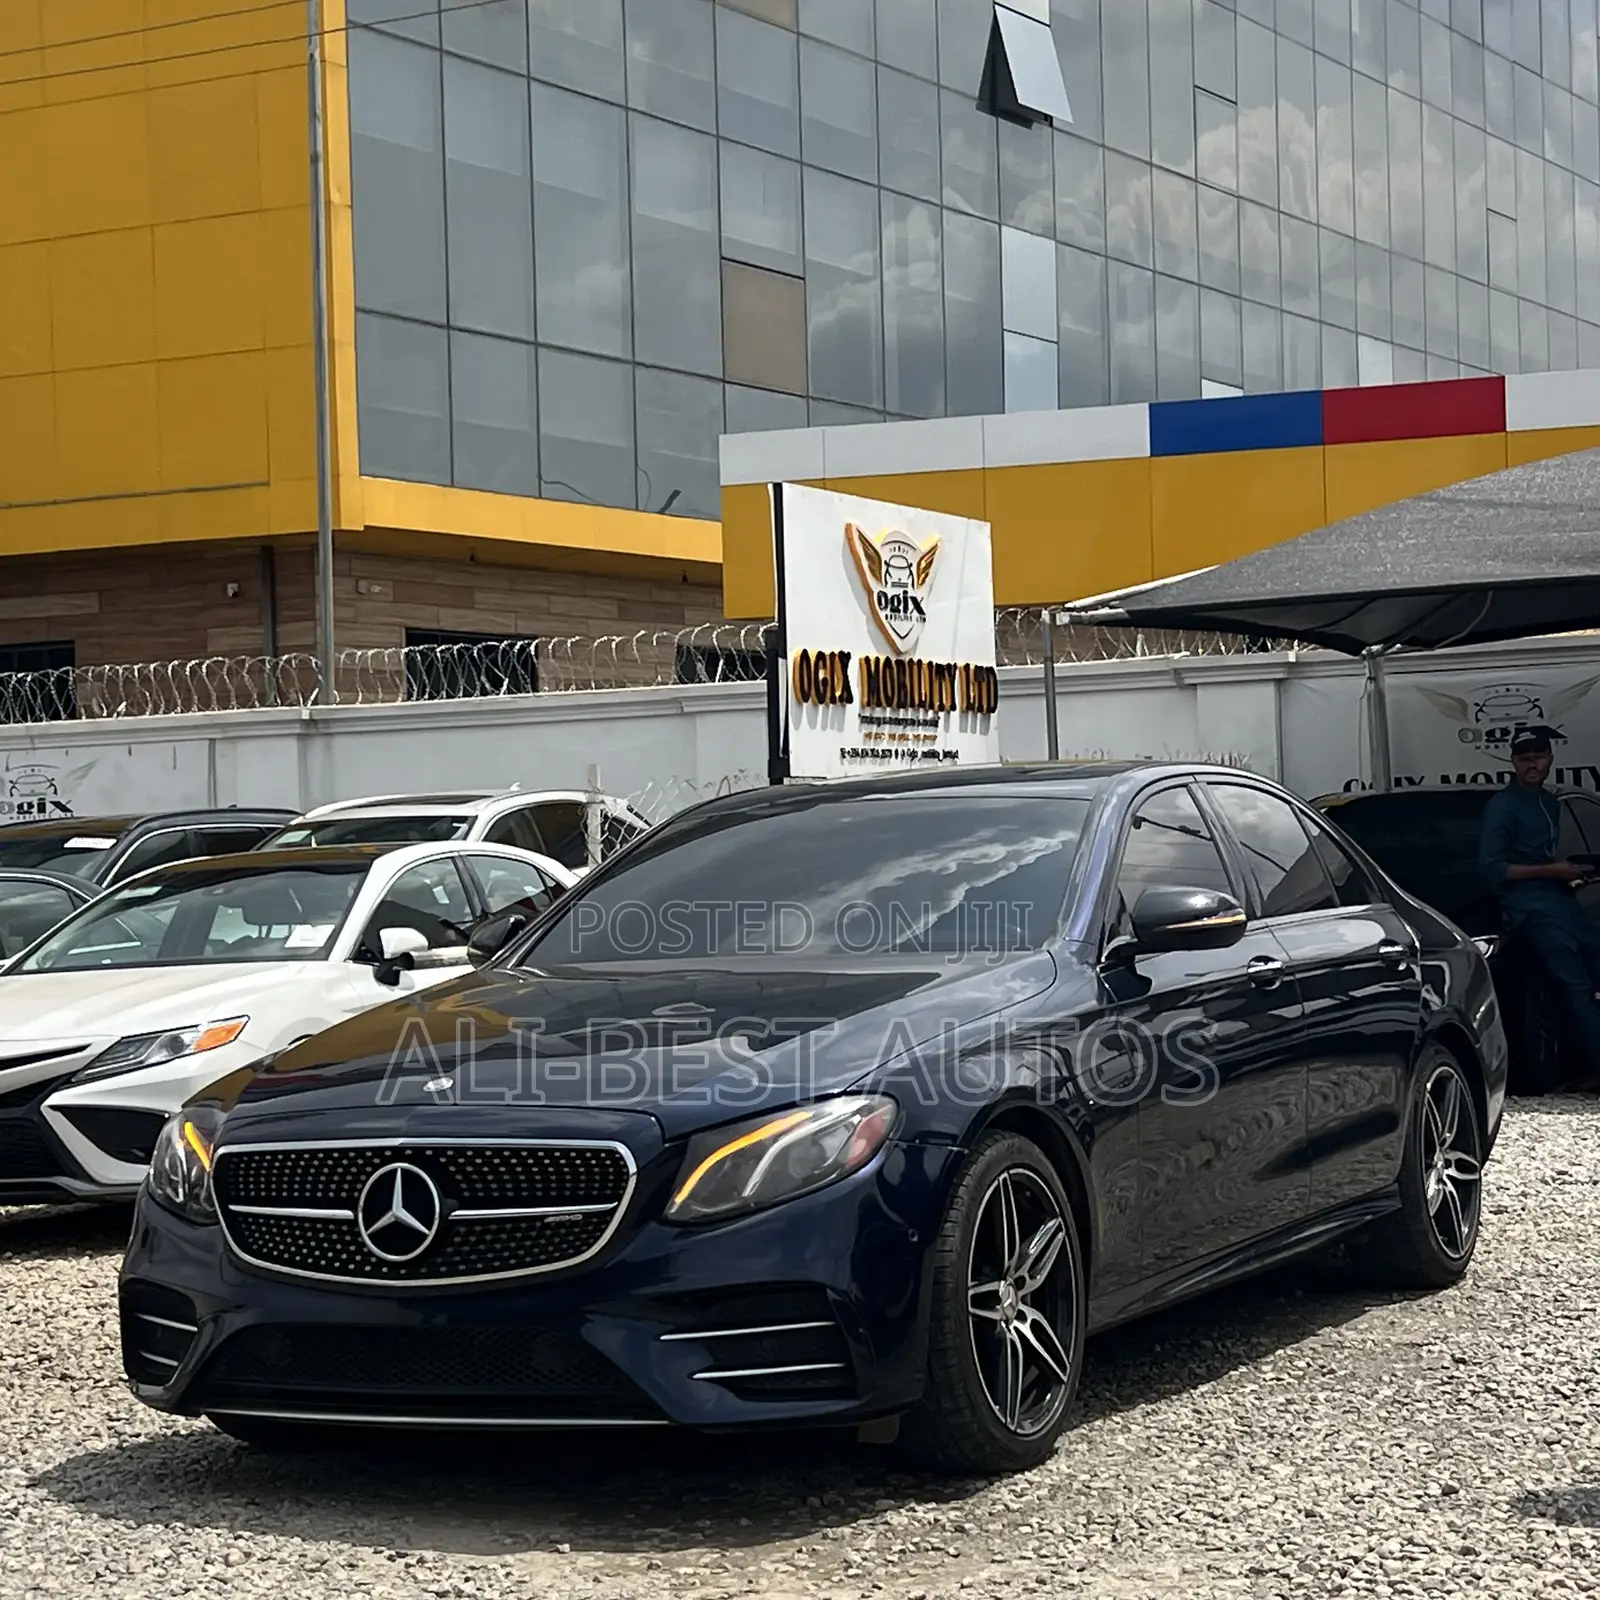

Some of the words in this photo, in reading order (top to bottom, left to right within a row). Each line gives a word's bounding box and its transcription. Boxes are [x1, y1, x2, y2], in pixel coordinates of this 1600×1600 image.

[794, 649, 853, 705] OGIX
[859, 656, 957, 713] MOBILITY
[958, 662, 998, 714] LTD
